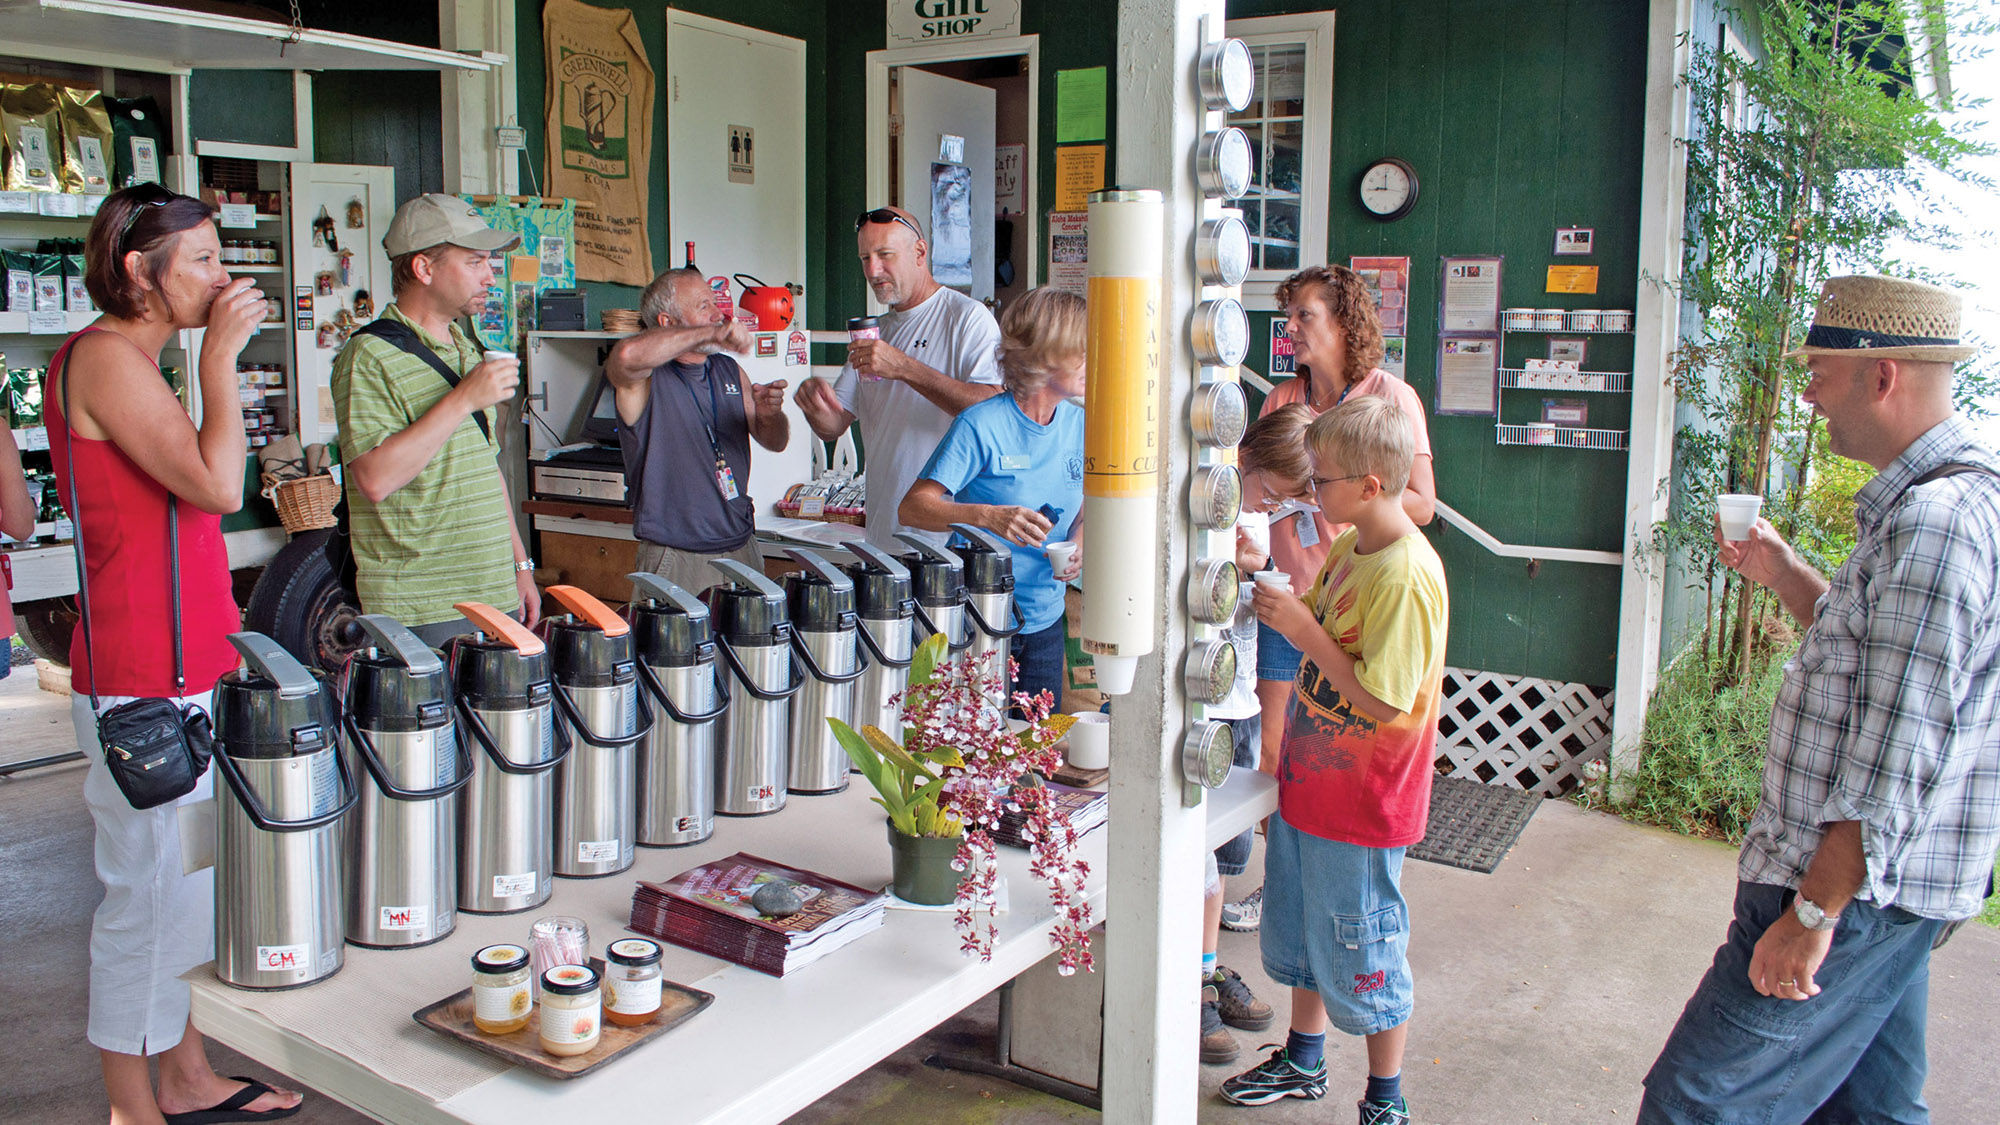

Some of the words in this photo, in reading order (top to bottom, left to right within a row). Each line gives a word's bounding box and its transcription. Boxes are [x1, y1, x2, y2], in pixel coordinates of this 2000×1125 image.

[921, 18, 982, 38] SHOP
[563, 57, 628, 92] GREENWELL
[1275, 355, 1290, 373] By
[759, 785, 775, 800] DK
[389, 908, 411, 927] MN
[268, 951, 296, 969] CM
[1354, 969, 1385, 993] 23
